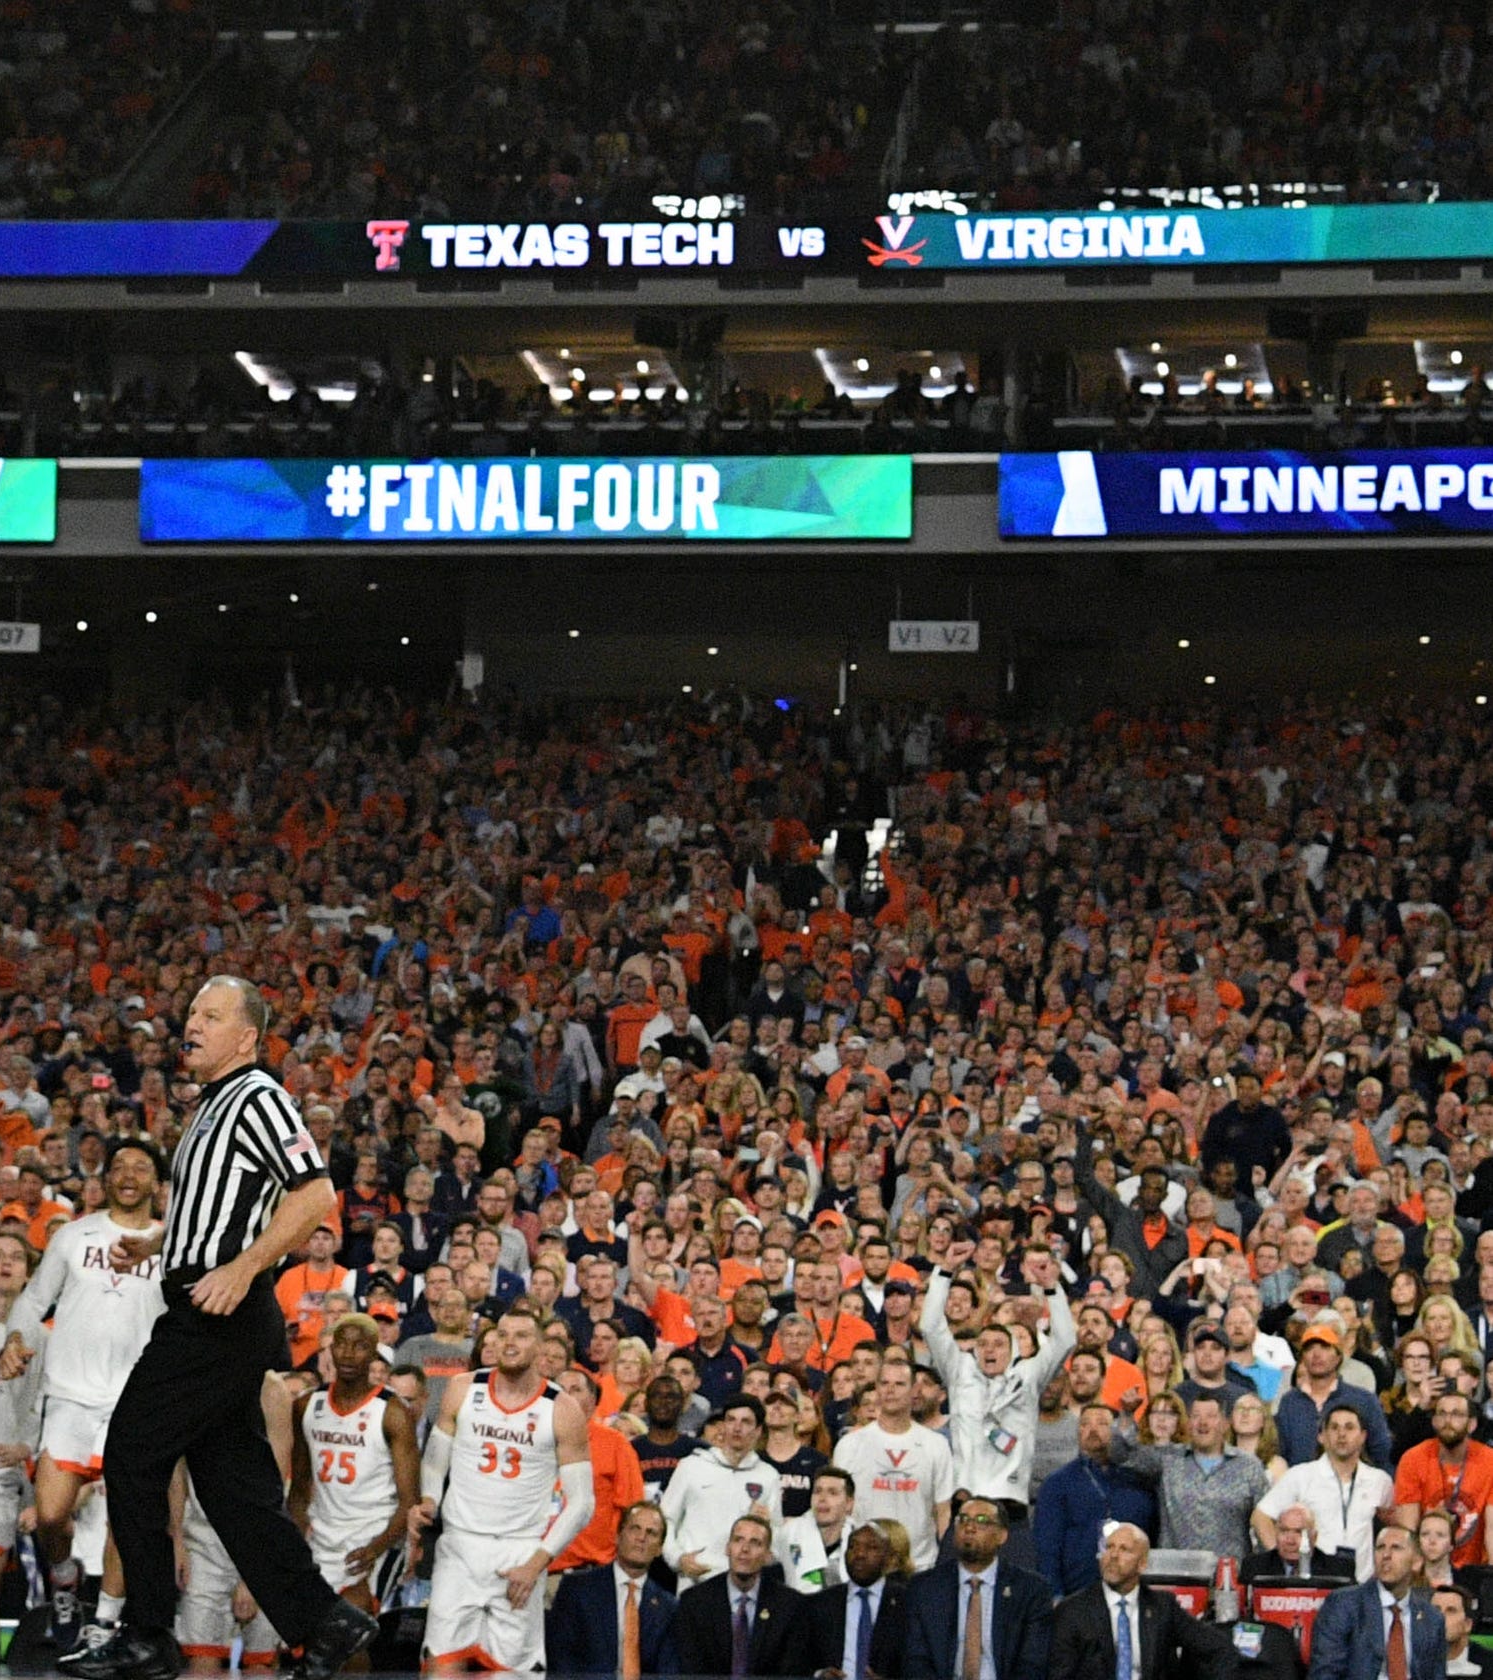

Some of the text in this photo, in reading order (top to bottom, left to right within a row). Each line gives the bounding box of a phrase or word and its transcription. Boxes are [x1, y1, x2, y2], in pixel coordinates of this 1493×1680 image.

[421, 222, 734, 268] TEXAS TECH
[955, 214, 1205, 260] VIRGINIA
[324, 463, 720, 533] #FINALFOUR
[943, 626, 971, 645] V2
[82, 1246, 161, 1280] FALY
[311, 1428, 366, 1447] VIRGINIA
[471, 1422, 534, 1447] VIRGINIA
[317, 1449, 357, 1484] 25
[478, 1441, 522, 1479] 33
